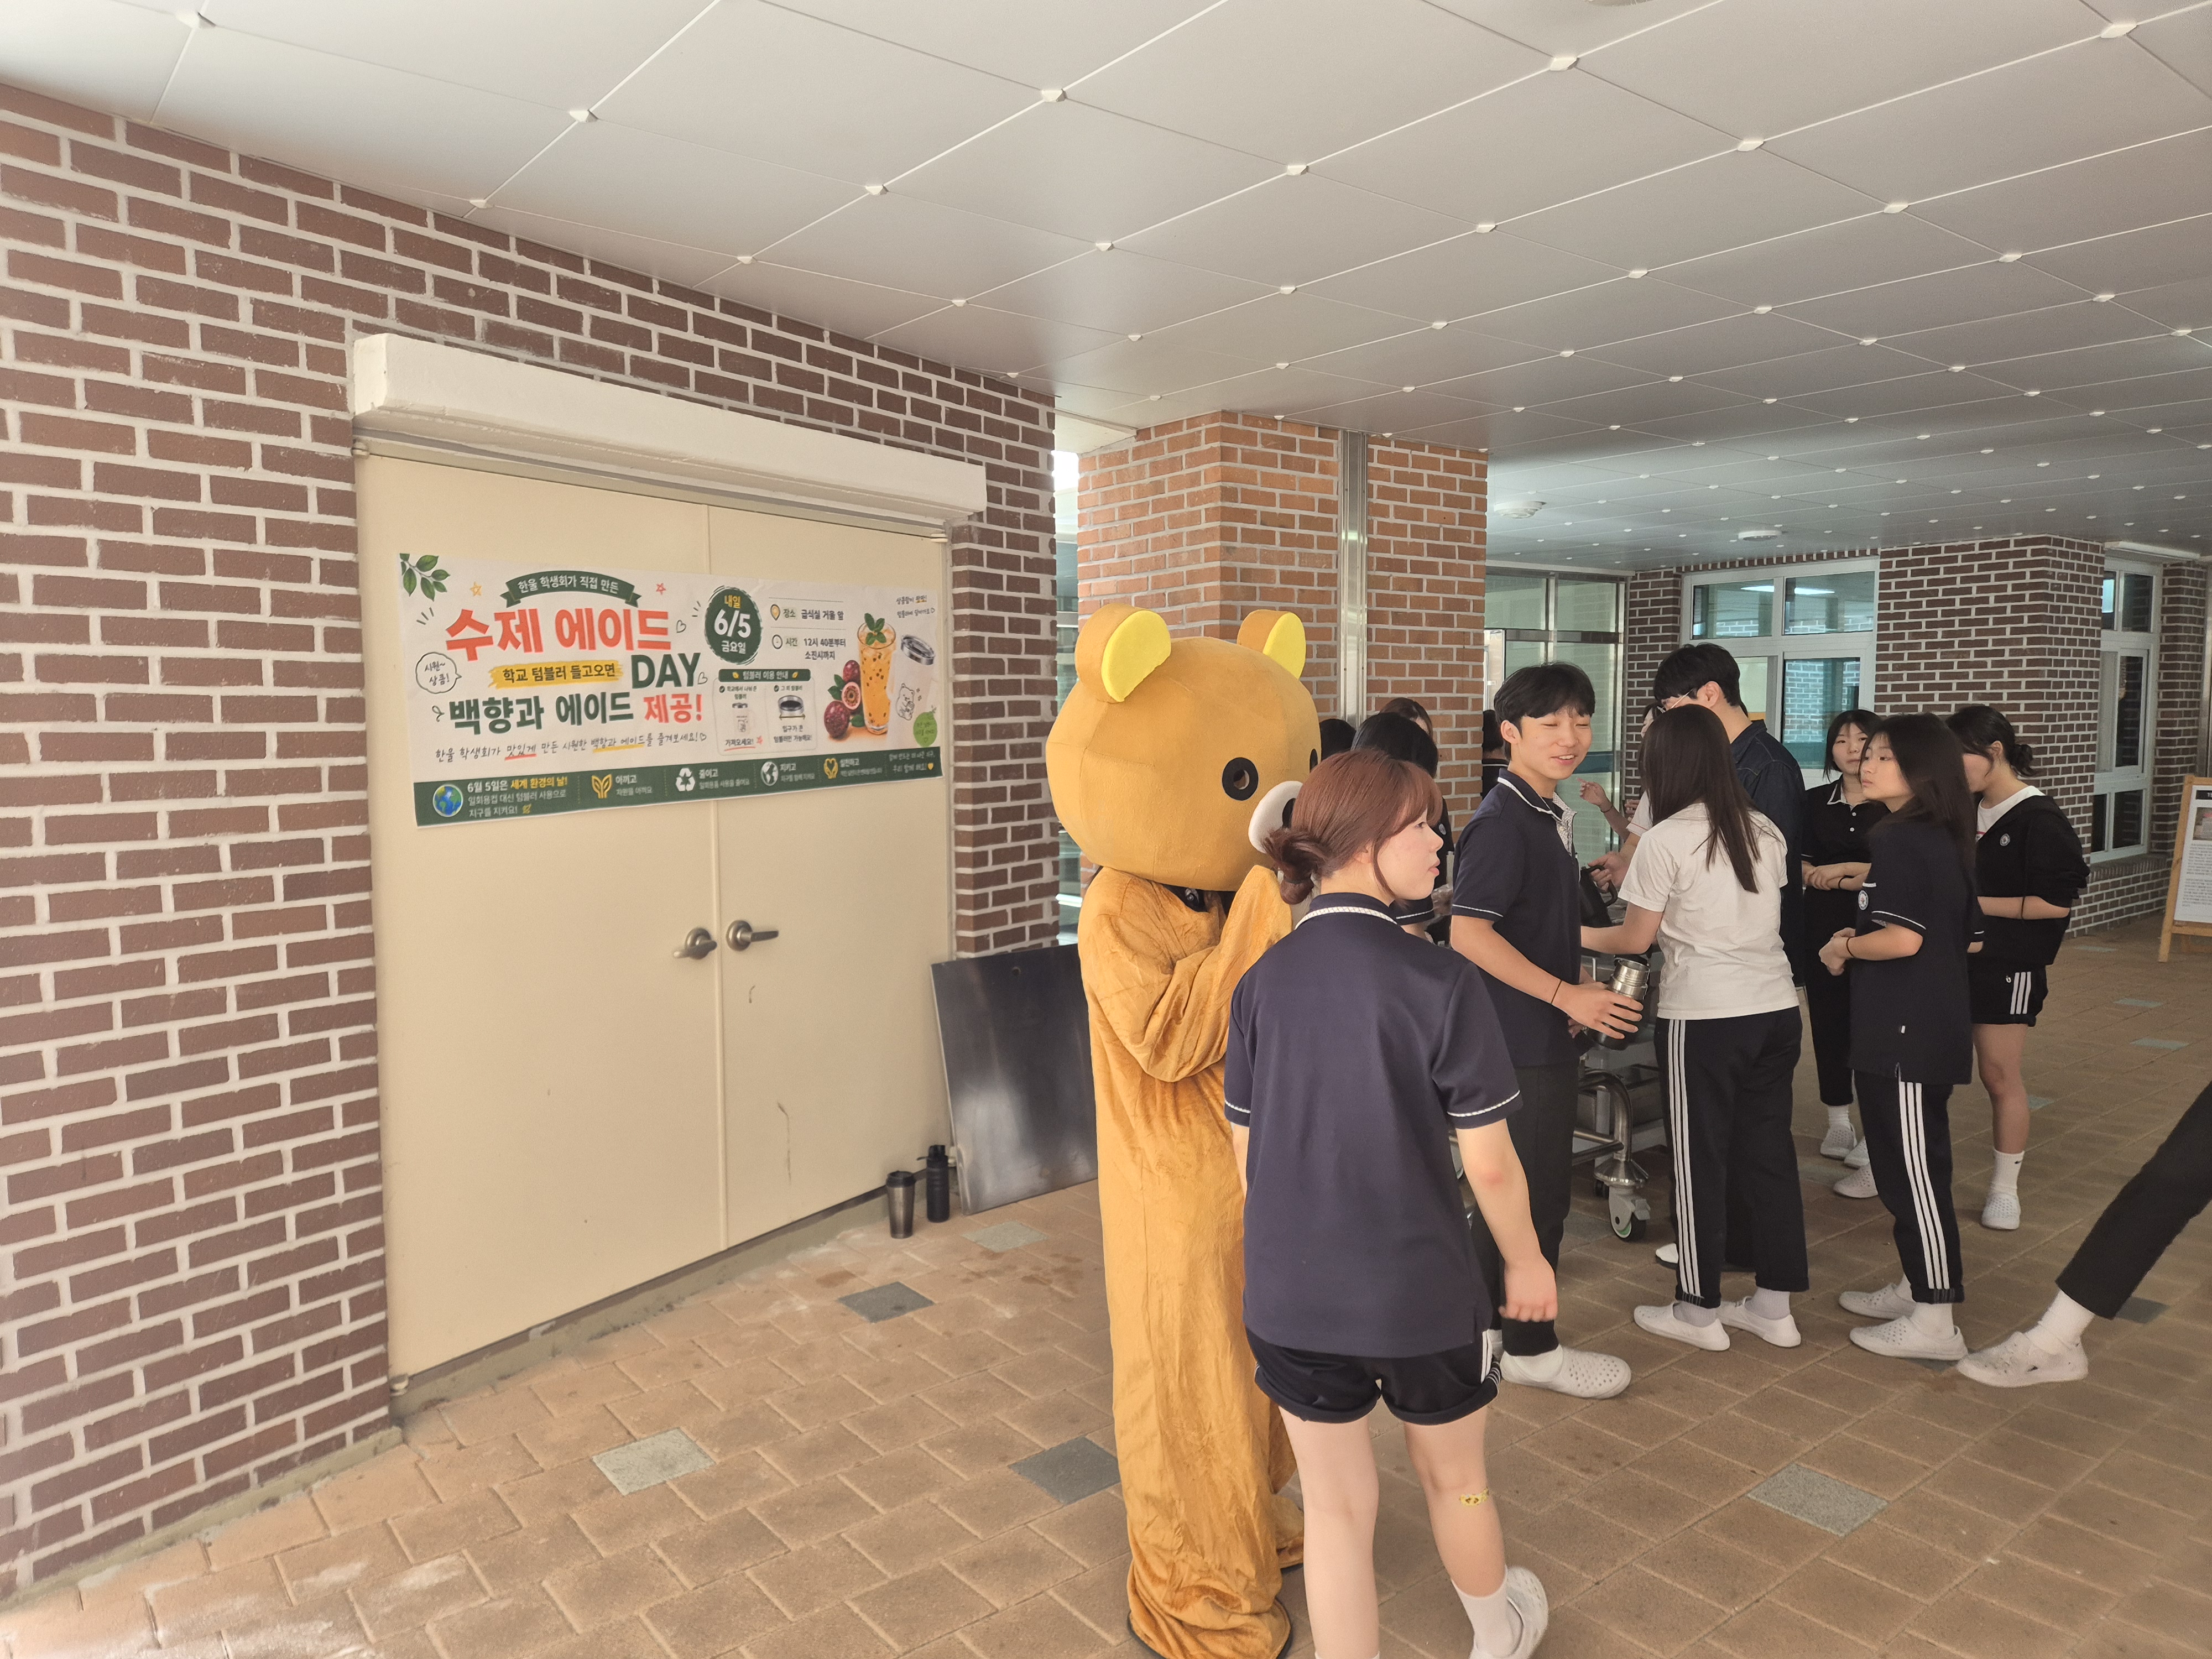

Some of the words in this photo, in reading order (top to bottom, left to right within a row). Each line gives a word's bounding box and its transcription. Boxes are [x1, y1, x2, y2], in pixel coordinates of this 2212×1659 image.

[518, 578, 538, 593] 한울
[539, 575, 577, 588] 학생회가
[580, 575, 597, 589] 직접
[600, 579, 619, 594] 만든
[724, 595, 740, 609] 내일
[783, 609, 796, 618] 장소
[801, 609, 821, 619] 급식실
[837, 611, 844, 620] 앞
[714, 609, 751, 638] 6/5
[446, 608, 544, 661] 수제
[555, 608, 671, 651] 에이드
[721, 640, 746, 654] 금요일
[786, 638, 797, 646] 시간
[804, 638, 818, 647] 12시
[820, 638, 846, 647] 40분부터
[805, 651, 836, 660] 소진시까지
[503, 667, 528, 683] 학교
[531, 666, 567, 682] 텀블러
[570, 663, 615, 679] 들고오면
[631, 653, 701, 688] DAY
[743, 671, 761, 680] 텀블러
[763, 671, 775, 680] 이용
[776, 671, 789, 680] 안내
[429, 673, 450, 686] 상큼!
[449, 696, 544, 735] 백향과
[555, 692, 634, 726] 에이드
[644, 693, 702, 724] 제공!
[436, 748, 455, 763] 한울
[460, 746, 500, 760] 학생회가
[507, 743, 536, 757] 맛있게
[541, 741, 559, 753] 만든
[563, 739, 587, 752] 시원한
[620, 733, 653, 747] 에이드를
[467, 781, 482, 793] 6월
[485, 780, 508, 791] 5일은
[511, 779, 528, 790] 세계
[530, 777, 555, 789] 환경의
[557, 776, 568, 787] 날!
[615, 775, 637, 785] 아끼고
[468, 794, 498, 806] 일회용컵
[499, 793, 514, 803] 대신
[516, 791, 538, 802] 텀블러
[539, 789, 566, 800] 사용으로
[469, 807, 491, 818] 지구를
